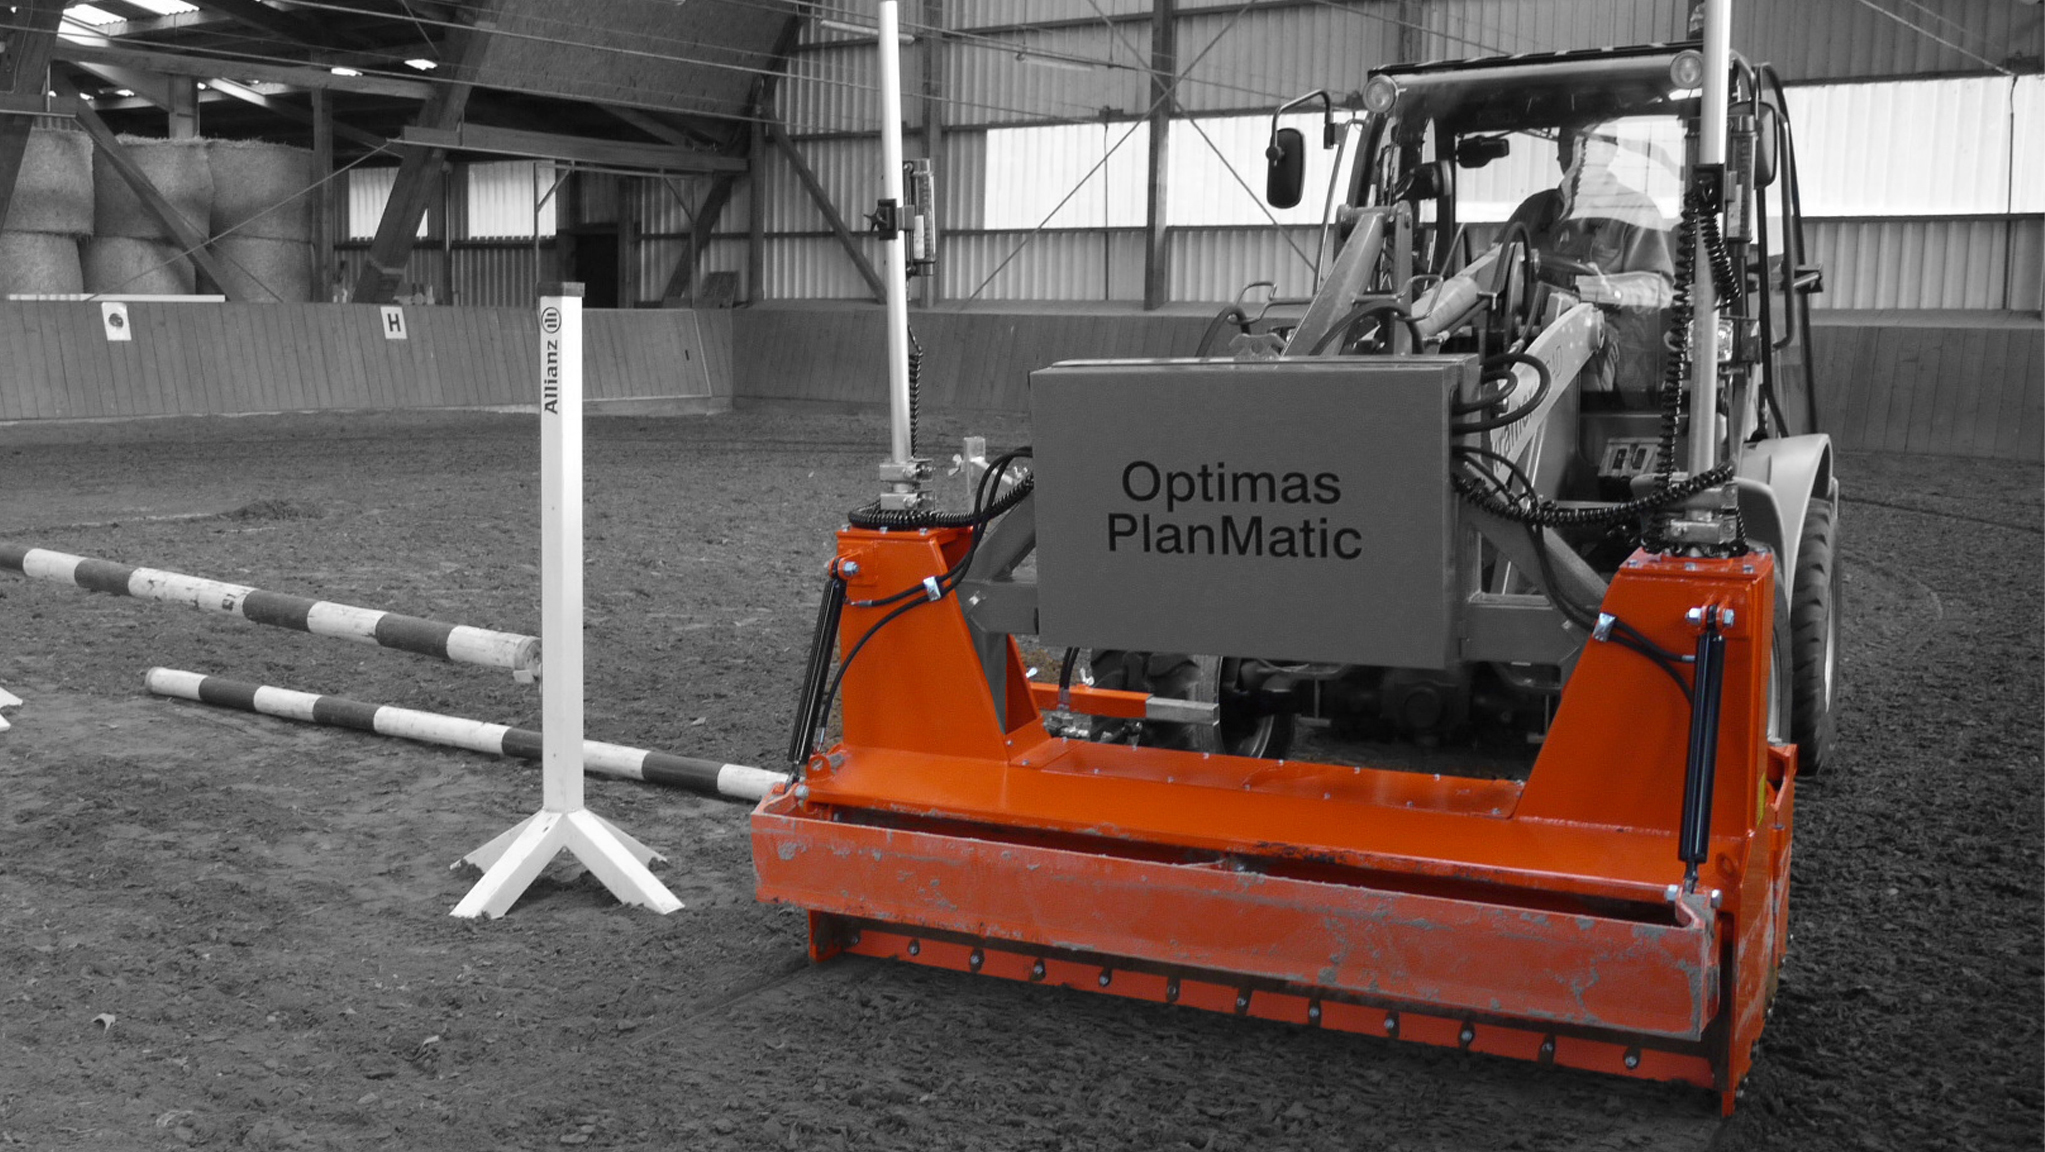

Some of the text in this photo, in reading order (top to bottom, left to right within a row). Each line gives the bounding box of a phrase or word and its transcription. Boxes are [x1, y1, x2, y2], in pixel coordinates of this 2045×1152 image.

[387, 313, 401, 332] H
[544, 339, 558, 415] Allianz
[1122, 460, 1341, 512] Optimas
[1108, 513, 1362, 560] PlanMatic
